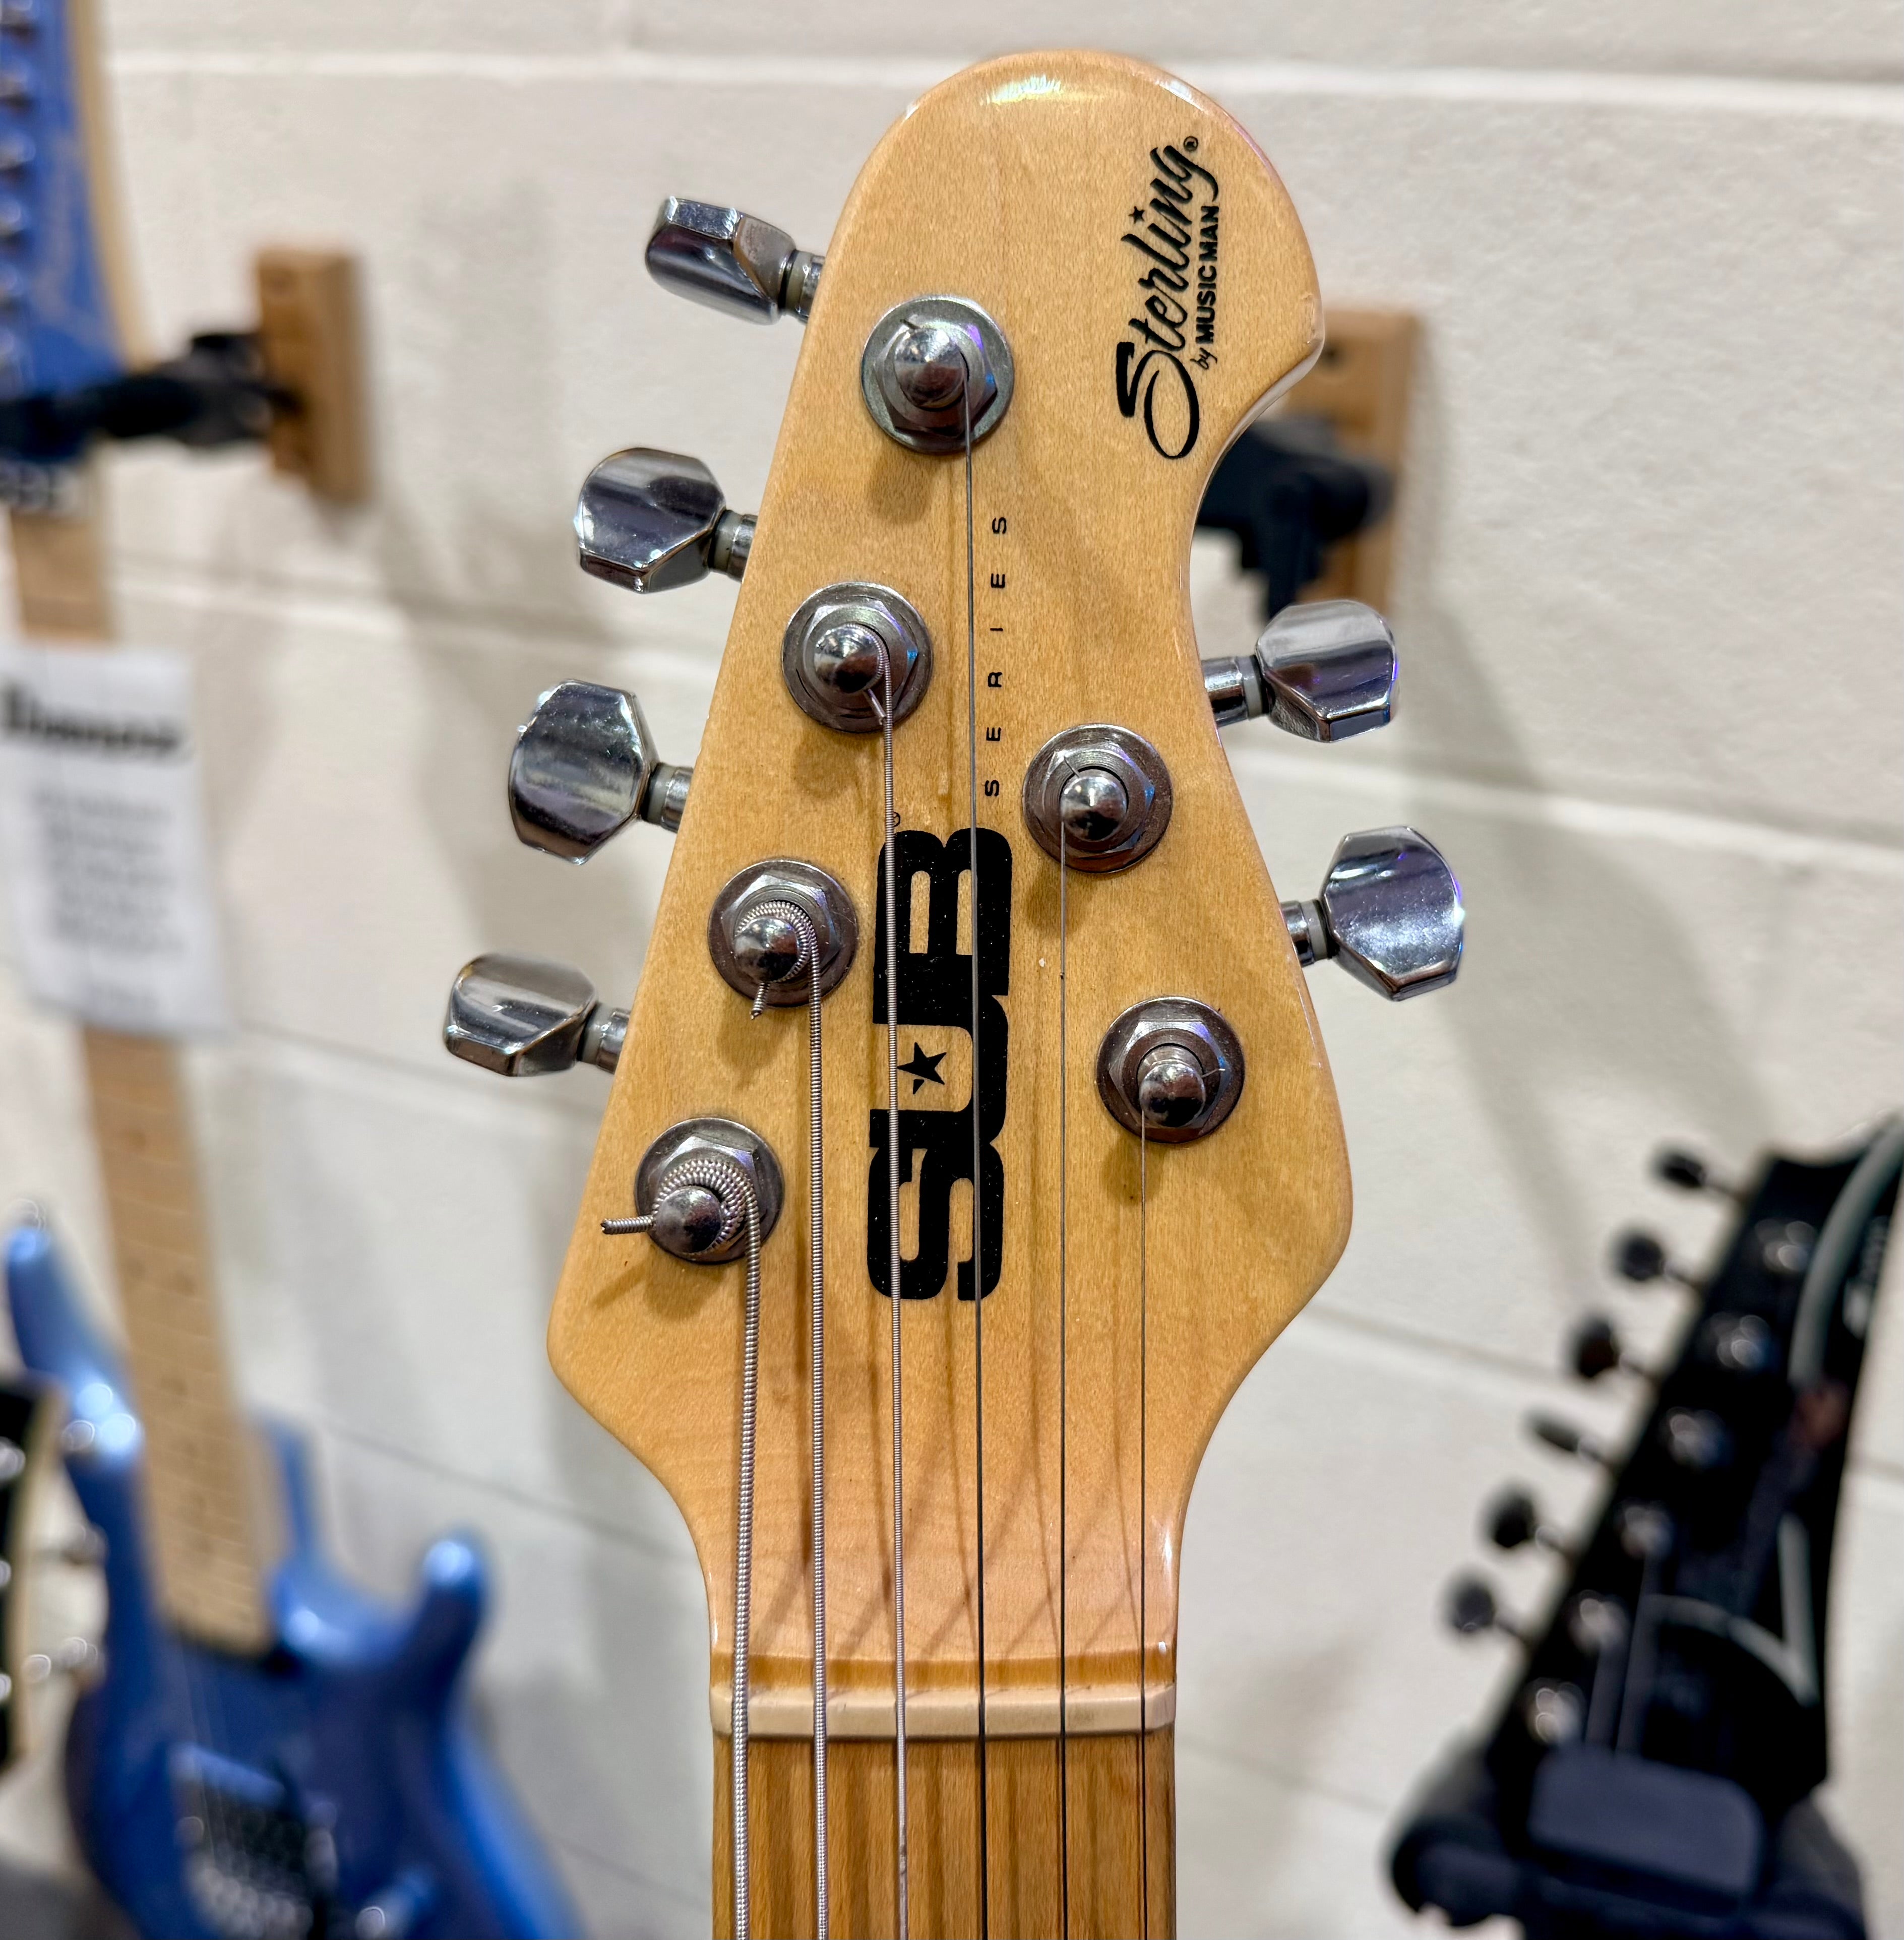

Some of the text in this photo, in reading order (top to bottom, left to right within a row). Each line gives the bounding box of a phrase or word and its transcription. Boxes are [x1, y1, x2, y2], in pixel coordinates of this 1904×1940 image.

[1190, 205, 1219, 370] by MUSIC MAN
[867, 517, 1013, 1301] SUB SERIES
